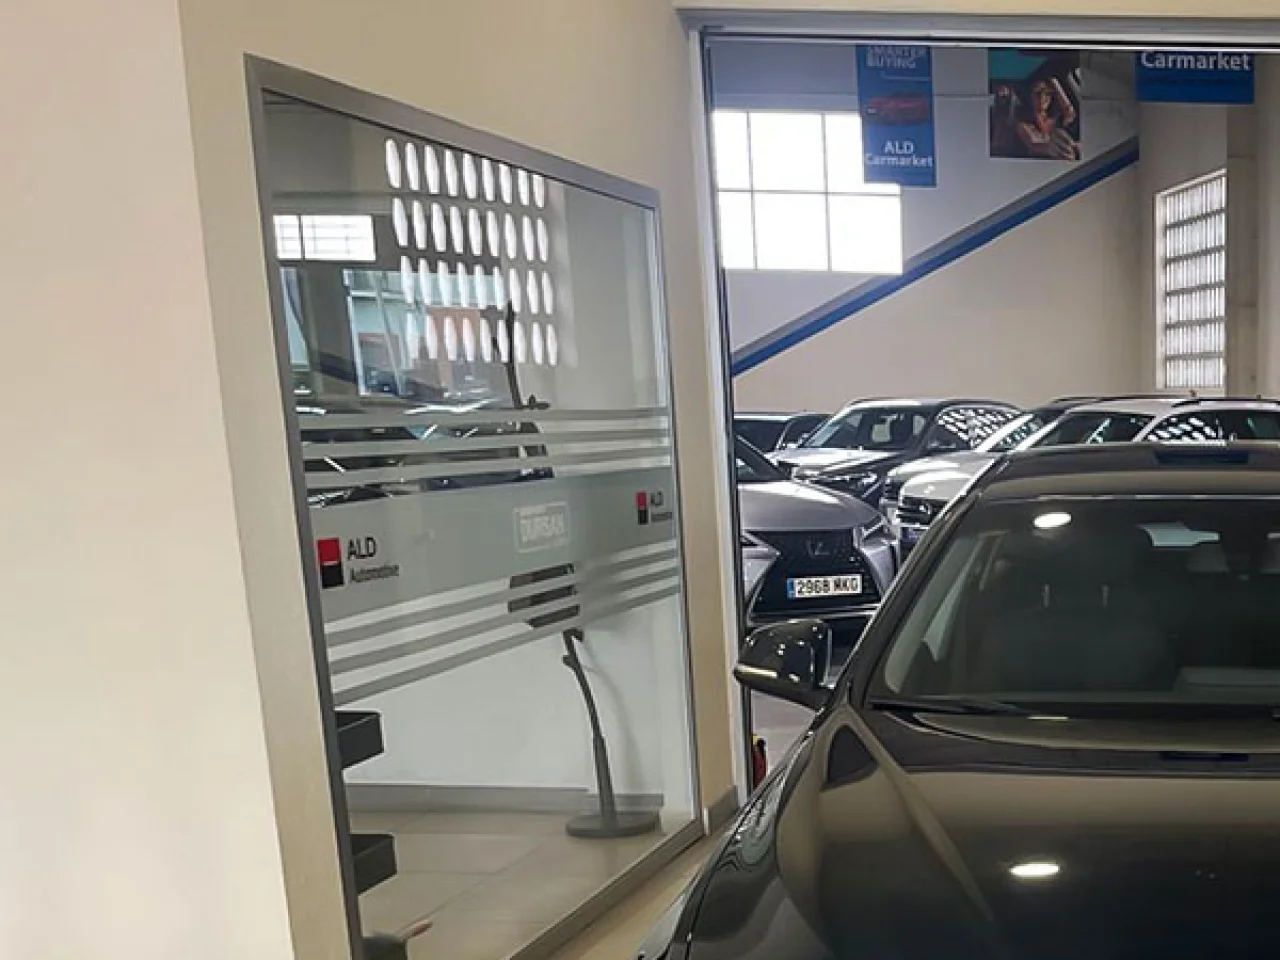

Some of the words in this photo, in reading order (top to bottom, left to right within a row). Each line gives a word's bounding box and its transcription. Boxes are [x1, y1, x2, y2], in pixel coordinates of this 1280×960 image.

[1140, 50, 1250, 70] Carmarket
[884, 140, 914, 155] ALD
[865, 153, 933, 168] Carmarket
[346, 536, 378, 561] ALD
